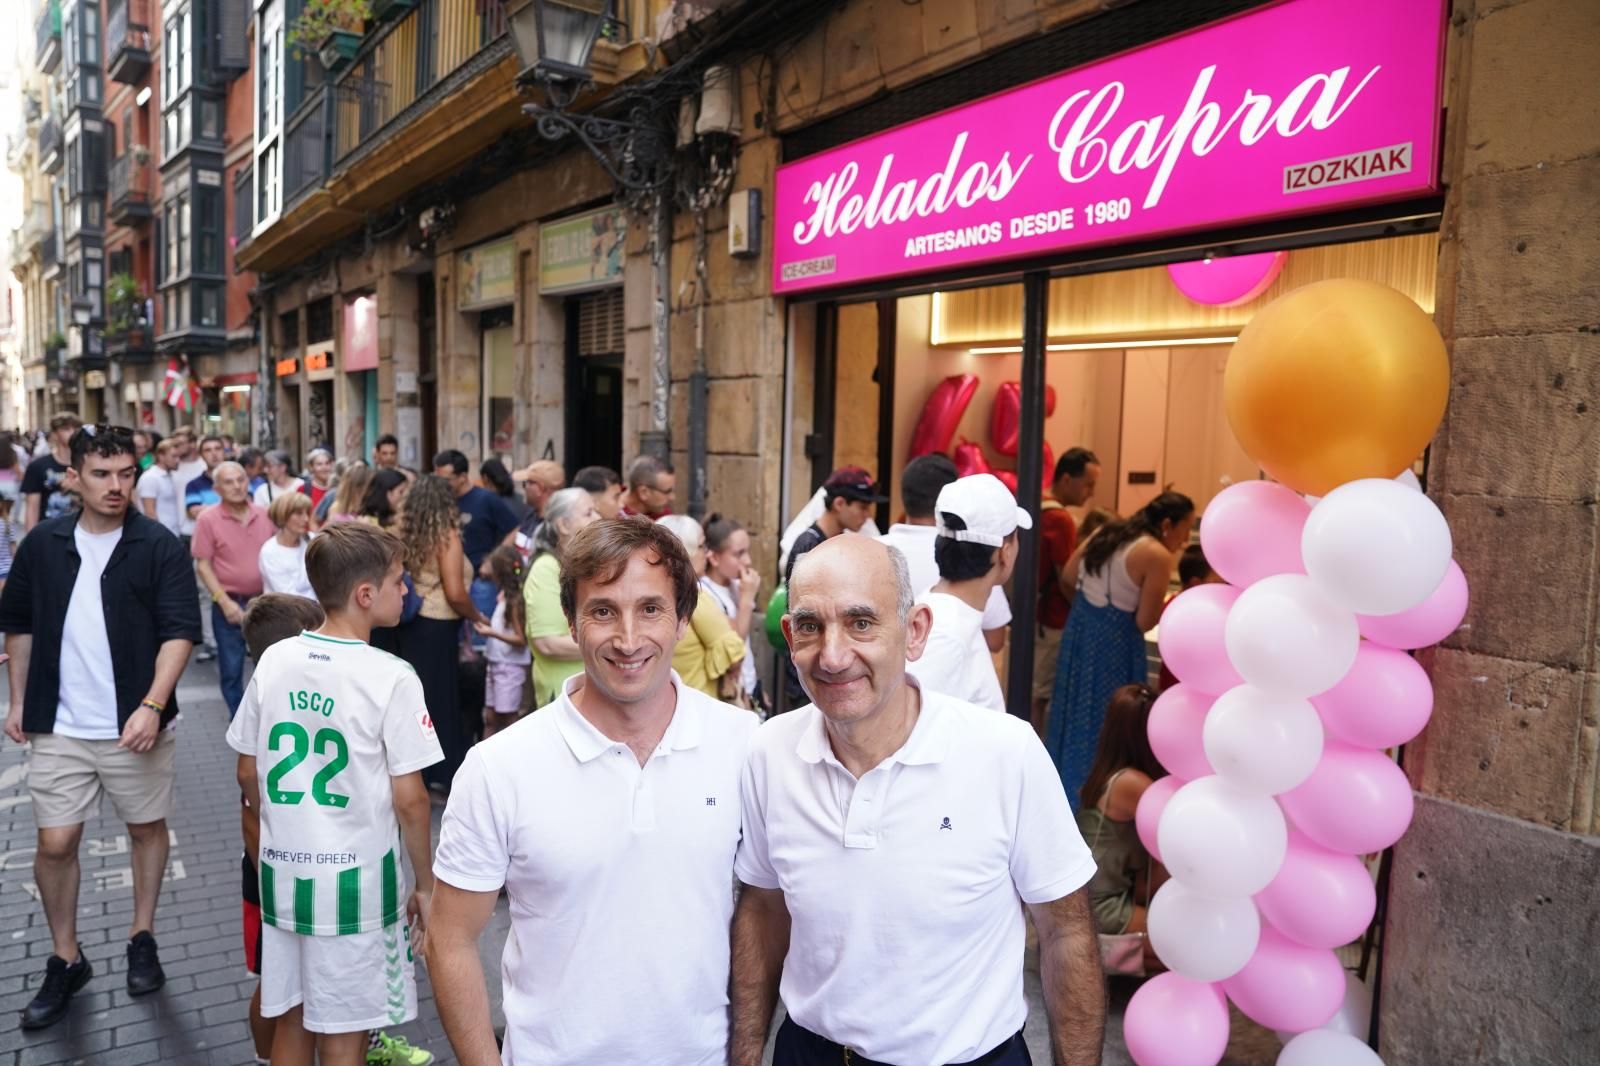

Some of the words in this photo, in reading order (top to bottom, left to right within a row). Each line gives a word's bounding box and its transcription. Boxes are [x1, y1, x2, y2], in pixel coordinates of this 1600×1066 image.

[793, 131, 1034, 245] Helados
[1048, 64, 1381, 210] Capra
[1286, 146, 1407, 190] IZOZKIAK
[905, 221, 1002, 258] ARTESANOS
[1010, 207, 1074, 239] DESDE
[1085, 197, 1131, 226] 1980
[783, 257, 836, 279] ICE-CREAM
[289, 690, 335, 717] ISCO
[267, 721, 350, 809] 22
[263, 847, 312, 864] FOREVER
[316, 852, 356, 865] GREEN
